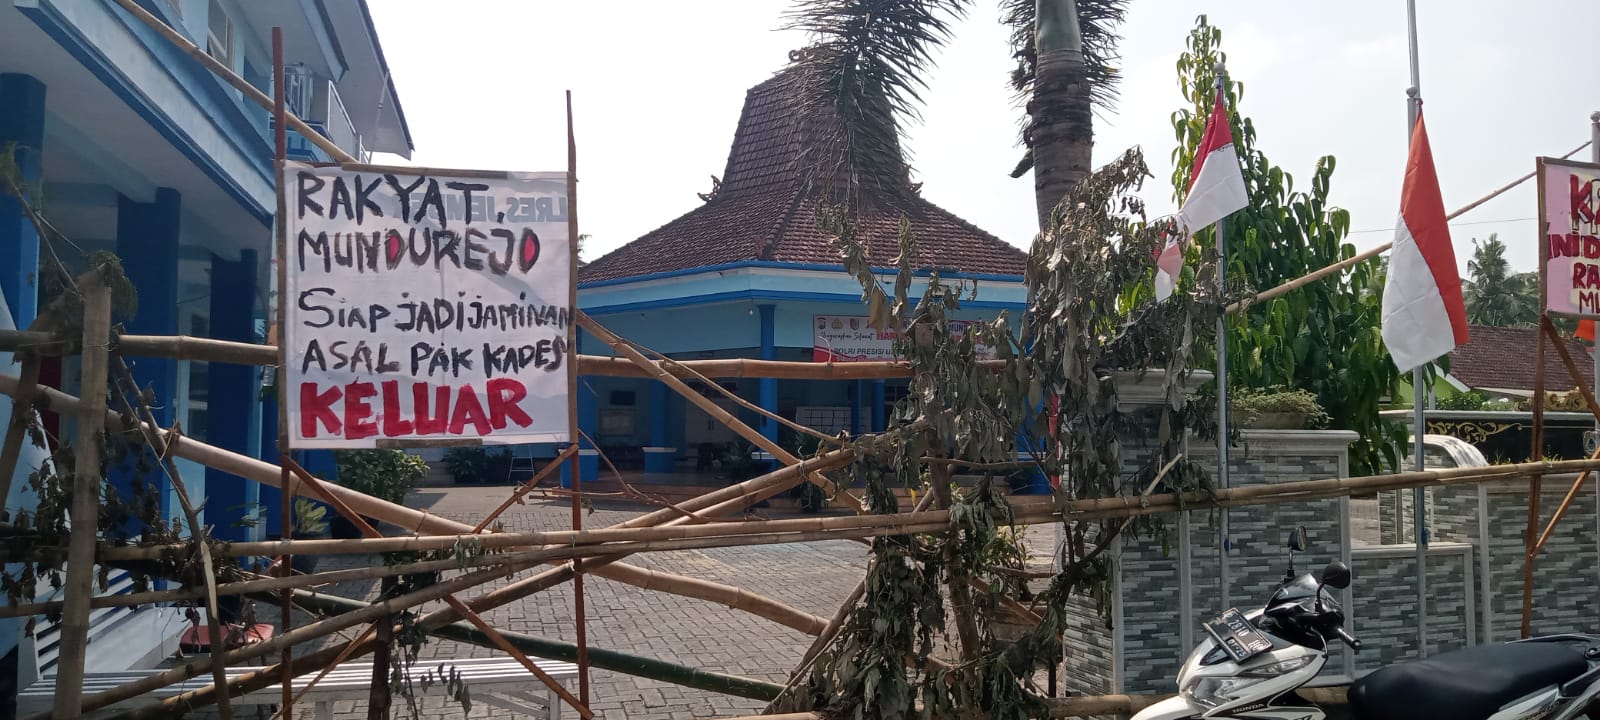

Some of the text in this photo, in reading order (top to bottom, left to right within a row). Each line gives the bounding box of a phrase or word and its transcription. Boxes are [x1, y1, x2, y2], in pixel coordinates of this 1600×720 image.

[1569, 173, 1600, 225] K
[299, 227, 540, 275] MUNDUREJO
[301, 335, 570, 379] ASAL PAK KADES
[300, 377, 533, 440] KELUAR
[1232, 703, 1265, 714] HONDA
